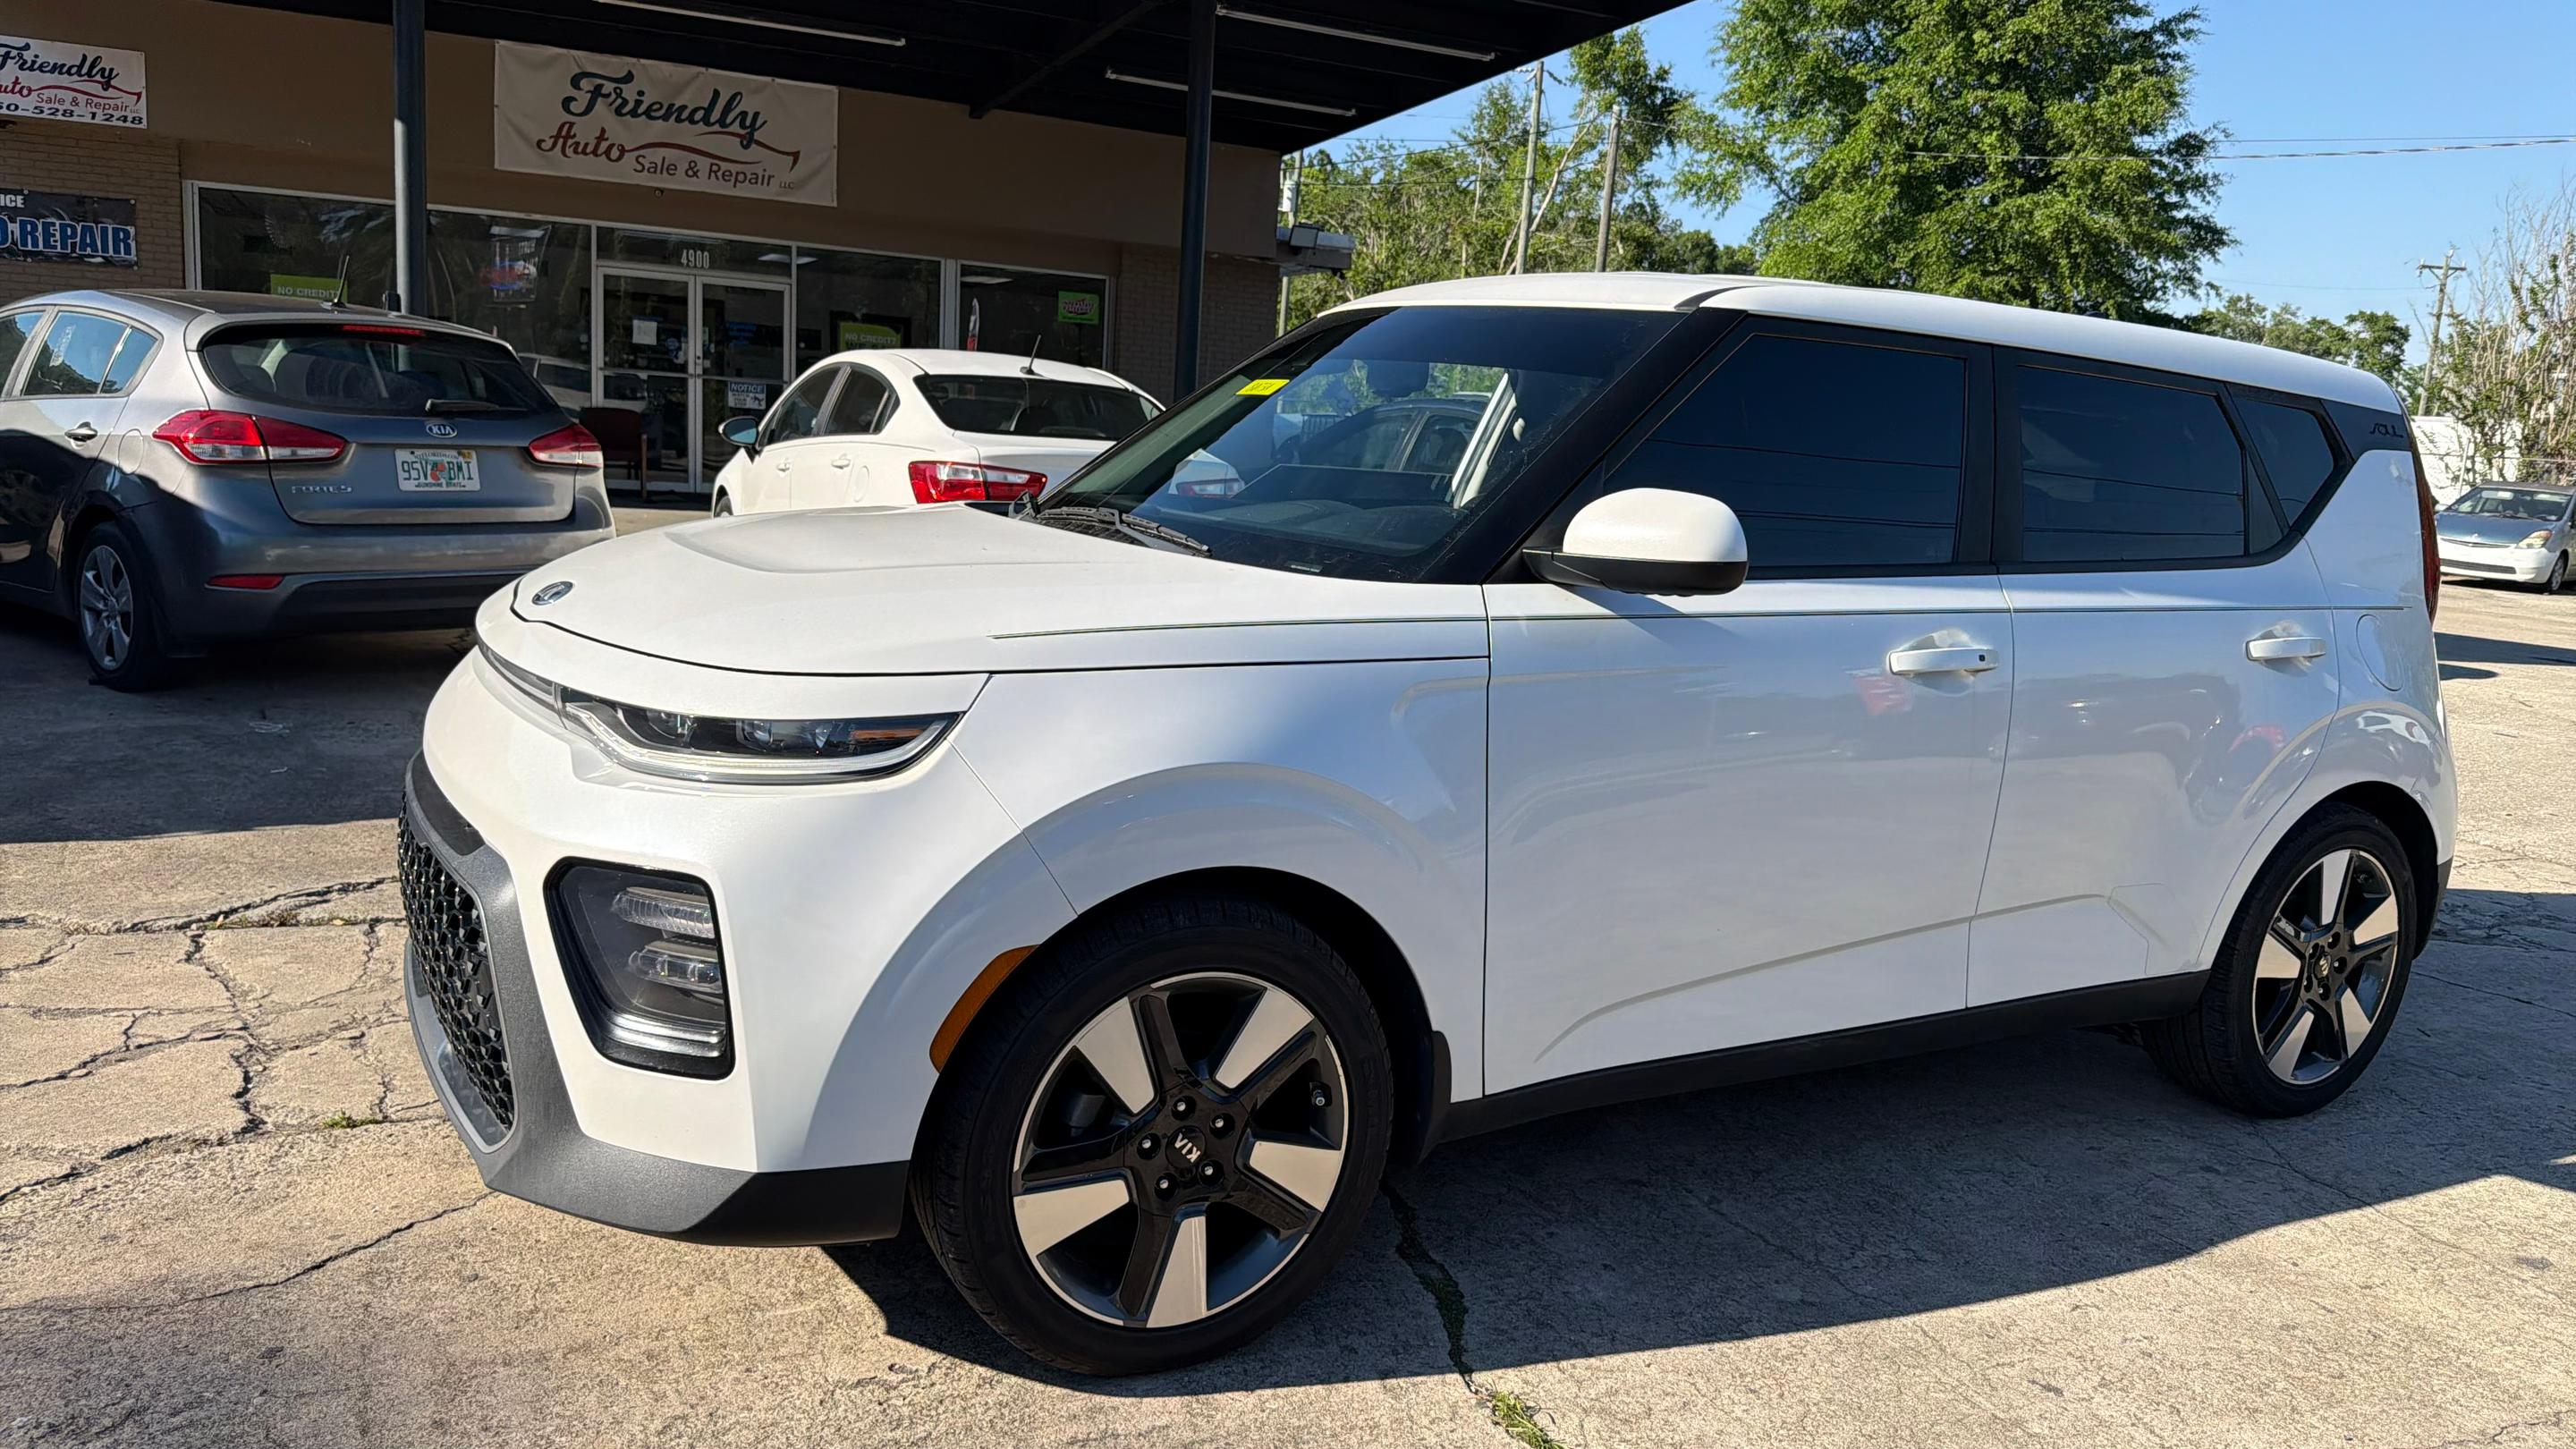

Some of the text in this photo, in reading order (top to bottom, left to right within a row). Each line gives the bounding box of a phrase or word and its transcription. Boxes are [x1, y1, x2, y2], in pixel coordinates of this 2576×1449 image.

[0, 42, 119, 91] Friendly
[0, 75, 32, 97] uto
[36, 92, 66, 106] Sale
[70, 96, 80, 107] &
[85, 97, 130, 113] Repair
[0, 101, 143, 125] 0-528-1248
[562, 70, 768, 150] Friendly
[537, 121, 794, 191] Auto Sale & Repair LLC
[0, 194, 25, 208] ICE
[17, 216, 134, 258] REPAIR
[681, 249, 710, 269] 4900
[277, 285, 293, 295] NO
[731, 383, 763, 394] NOTICE
[432, 425, 453, 435] KIA
[402, 461, 474, 480] 95V BMI
[1174, 1132, 1201, 1164] KIA
